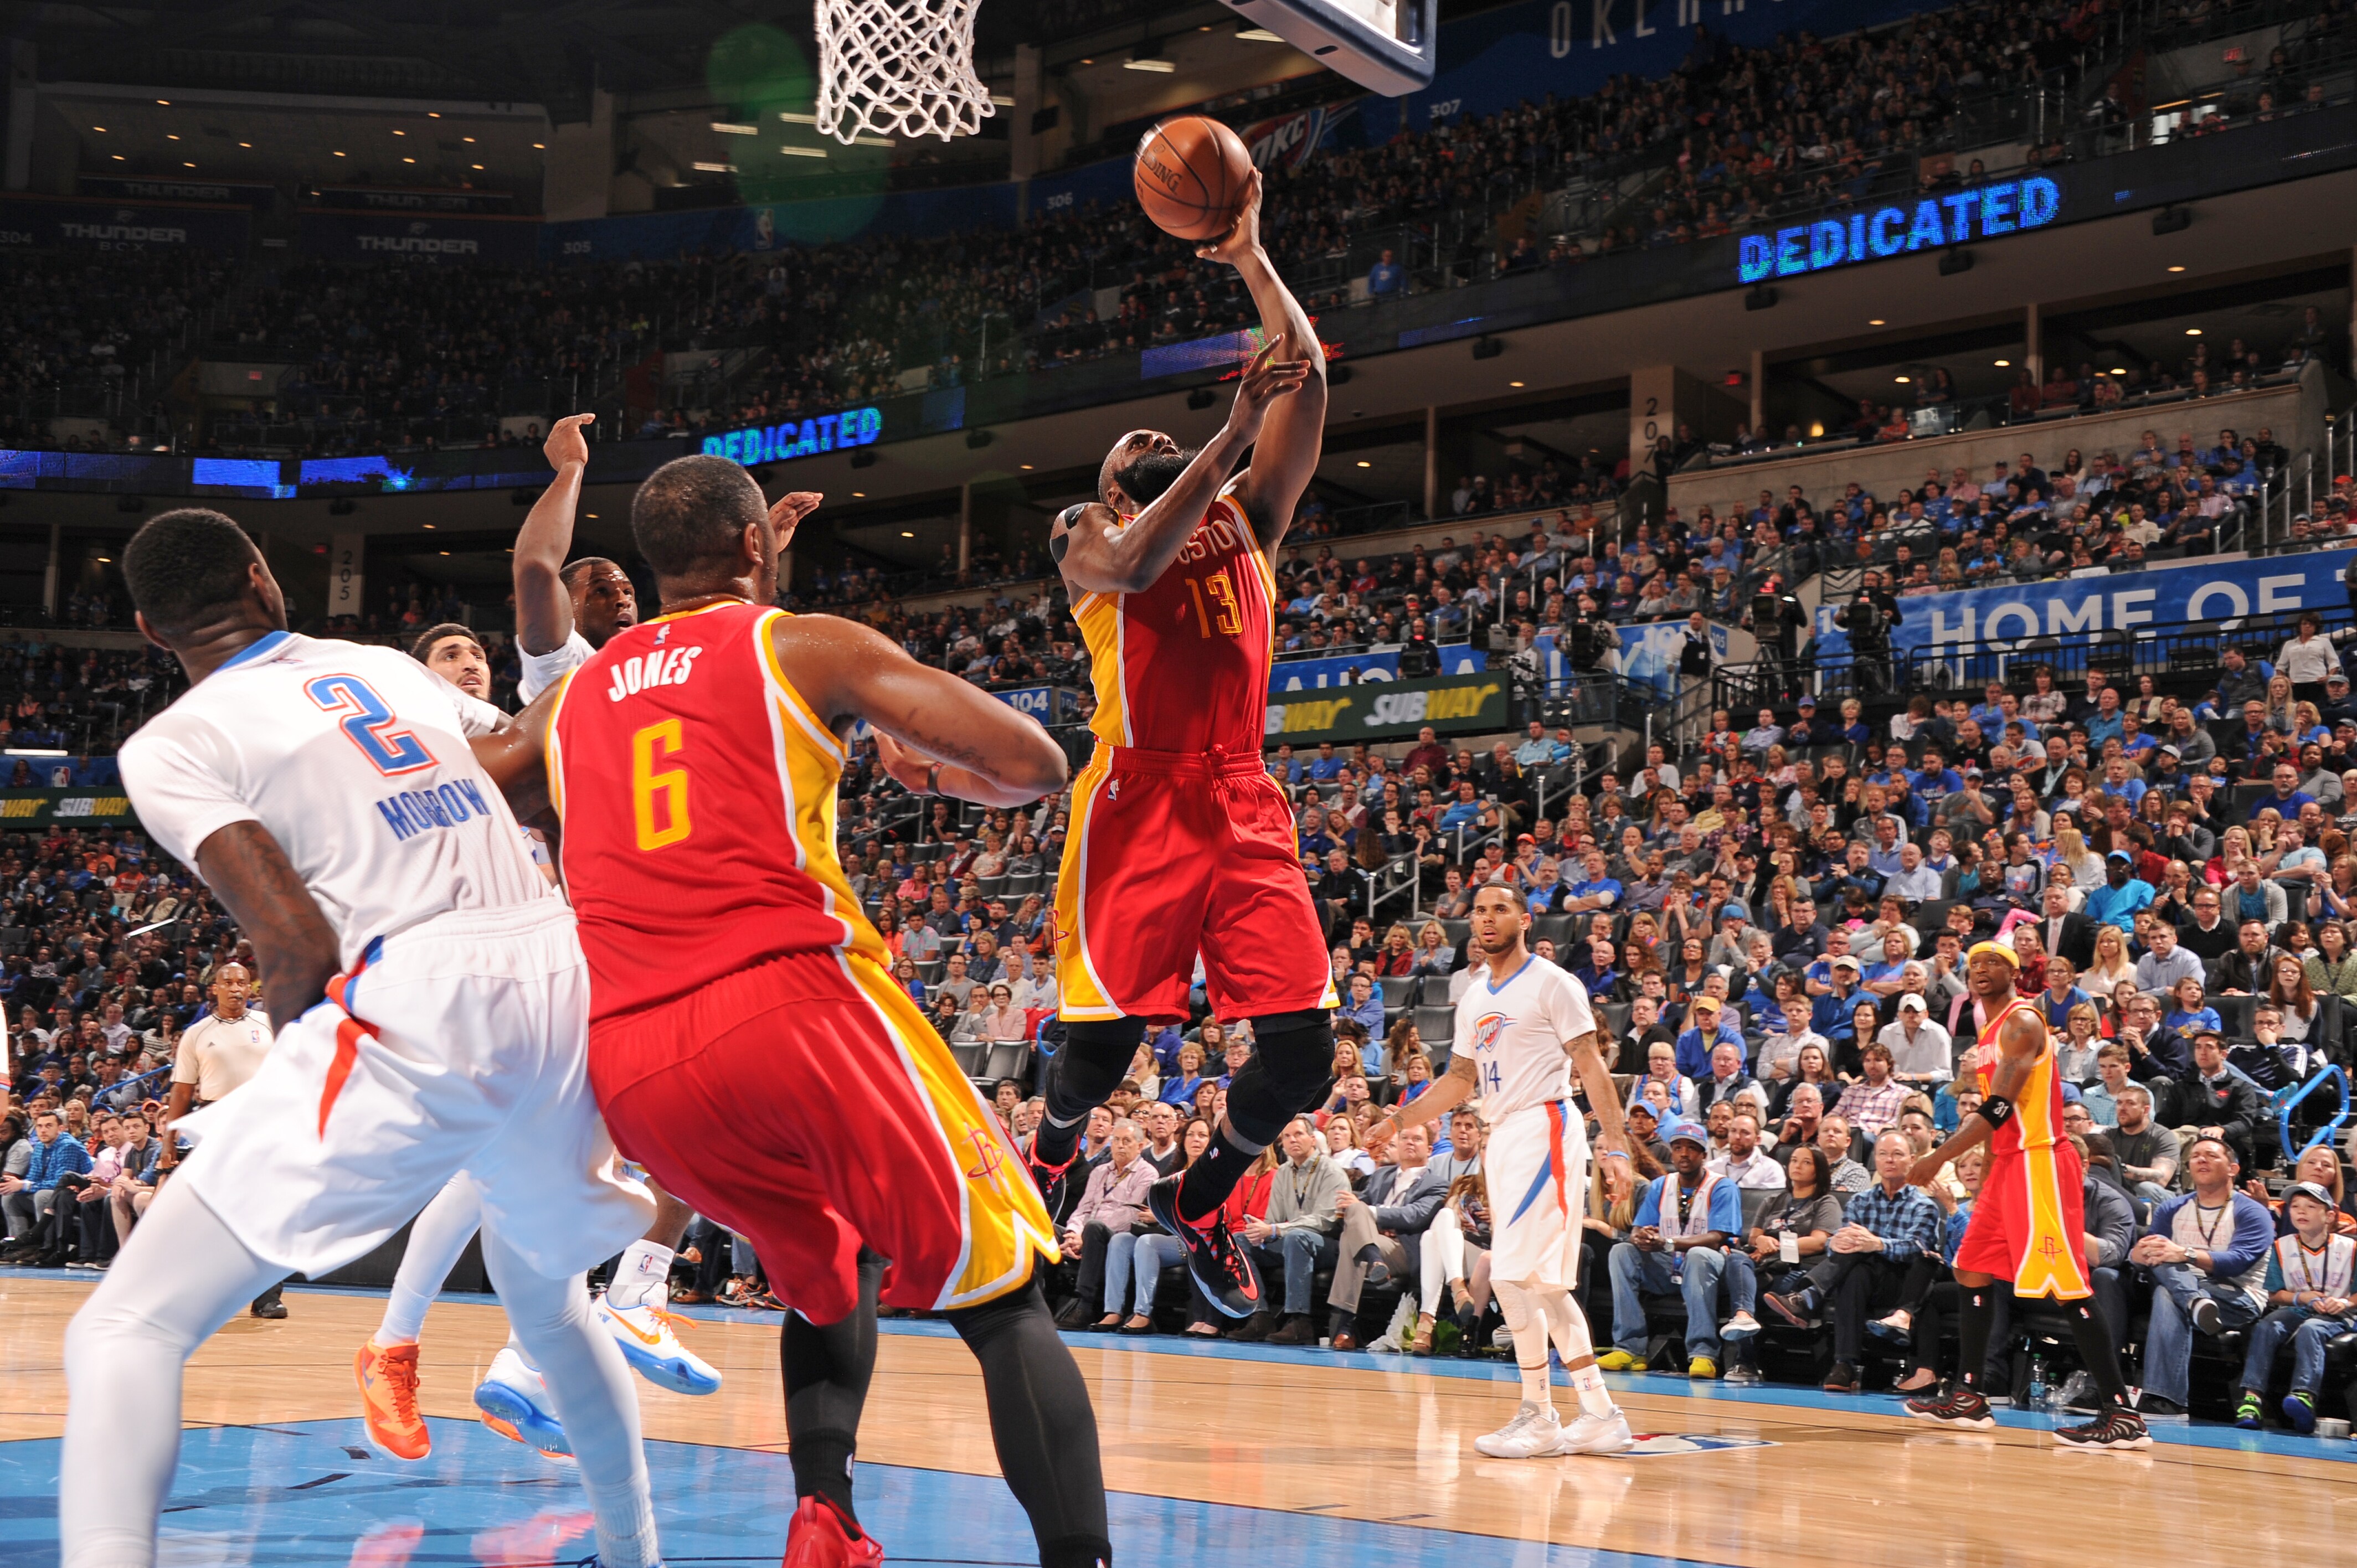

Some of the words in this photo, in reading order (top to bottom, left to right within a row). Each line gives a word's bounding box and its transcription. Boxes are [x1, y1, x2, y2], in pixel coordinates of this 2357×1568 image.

[1428, 99, 1461, 118] 307
[1047, 192, 1073, 209] 306
[61, 222, 187, 244] THUNDER
[357, 235, 478, 254] THUNDER
[563, 240, 590, 254] 305
[1738, 177, 2060, 283] DEDICATED
[703, 407, 882, 466] DEDICATED
[1185, 574, 1242, 638] 13
[1931, 589, 2157, 662] HOME
[608, 646, 703, 702] JONES
[1010, 691, 1048, 714] 104
[1363, 682, 1501, 726] SUBWAY
[304, 673, 440, 776] 2
[633, 718, 692, 851] 6
[1483, 1061, 1501, 1094] 14
[1993, 1101, 2009, 1117] 31
